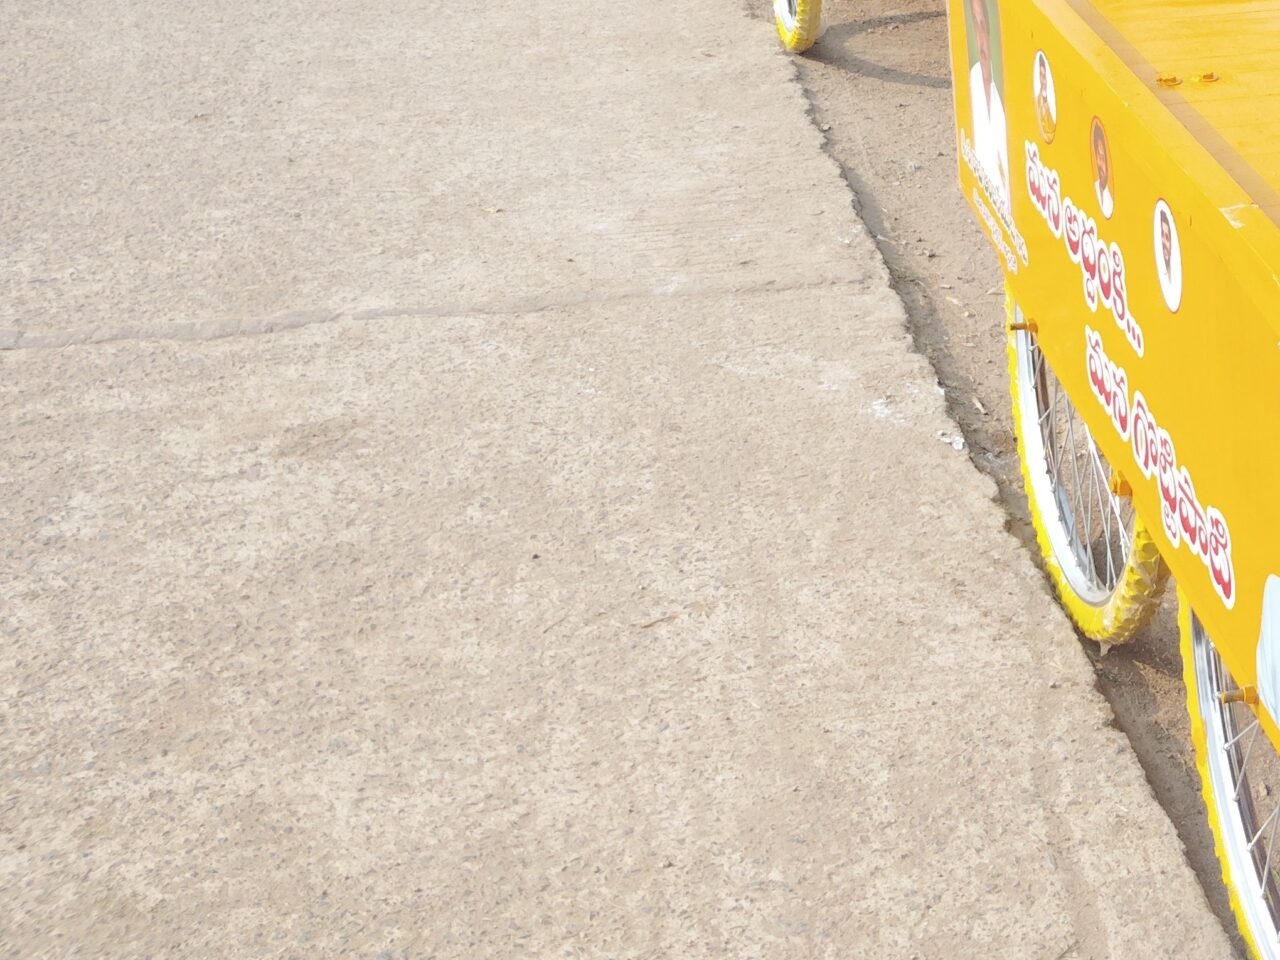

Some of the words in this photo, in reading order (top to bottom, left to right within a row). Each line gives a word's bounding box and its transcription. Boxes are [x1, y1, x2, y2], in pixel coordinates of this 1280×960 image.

[1026, 142, 1061, 236] మన
[1086, 328, 1130, 439] మన
[1131, 393, 1234, 607] గొట్టిపాటి
